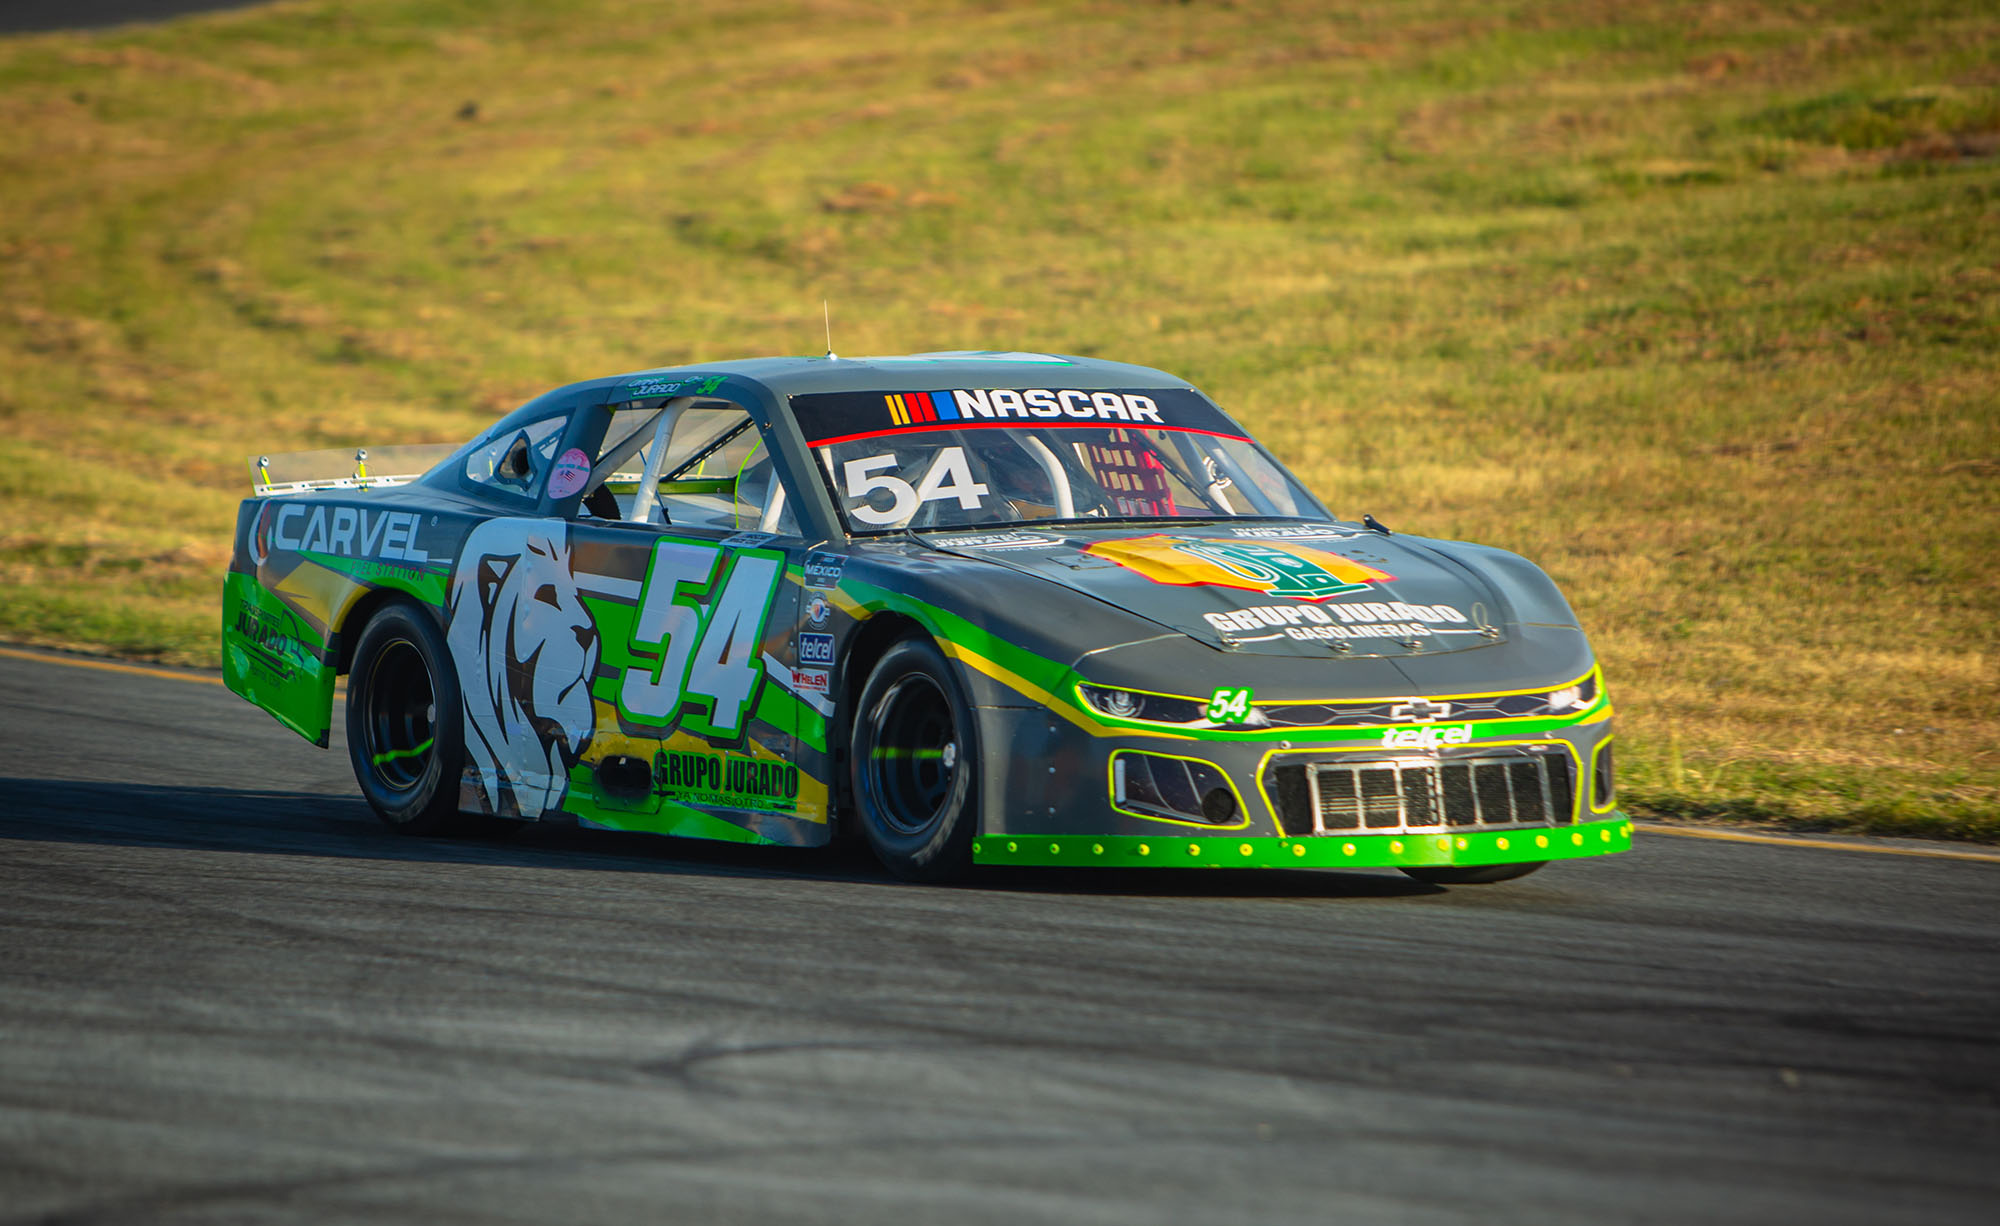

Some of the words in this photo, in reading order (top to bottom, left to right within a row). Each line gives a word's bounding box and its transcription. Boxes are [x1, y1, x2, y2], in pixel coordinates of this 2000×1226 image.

[952, 388, 1165, 424] NASCAR
[843, 446, 990, 525] 54
[275, 503, 428, 563] CARVEL
[375, 562, 425, 582] STATION
[1202, 604, 1330, 632] GRUPO
[1327, 601, 1468, 624] JURADO
[1284, 623, 1432, 642] GASOLINERAS
[236, 611, 288, 657] JURADO
[620, 540, 781, 730] 54
[801, 637, 833, 660] telcel
[1208, 690, 1249, 719] 54
[1381, 724, 1472, 749] telcel
[654, 751, 721, 791] GRUPO
[725, 759, 798, 799] JURADO
